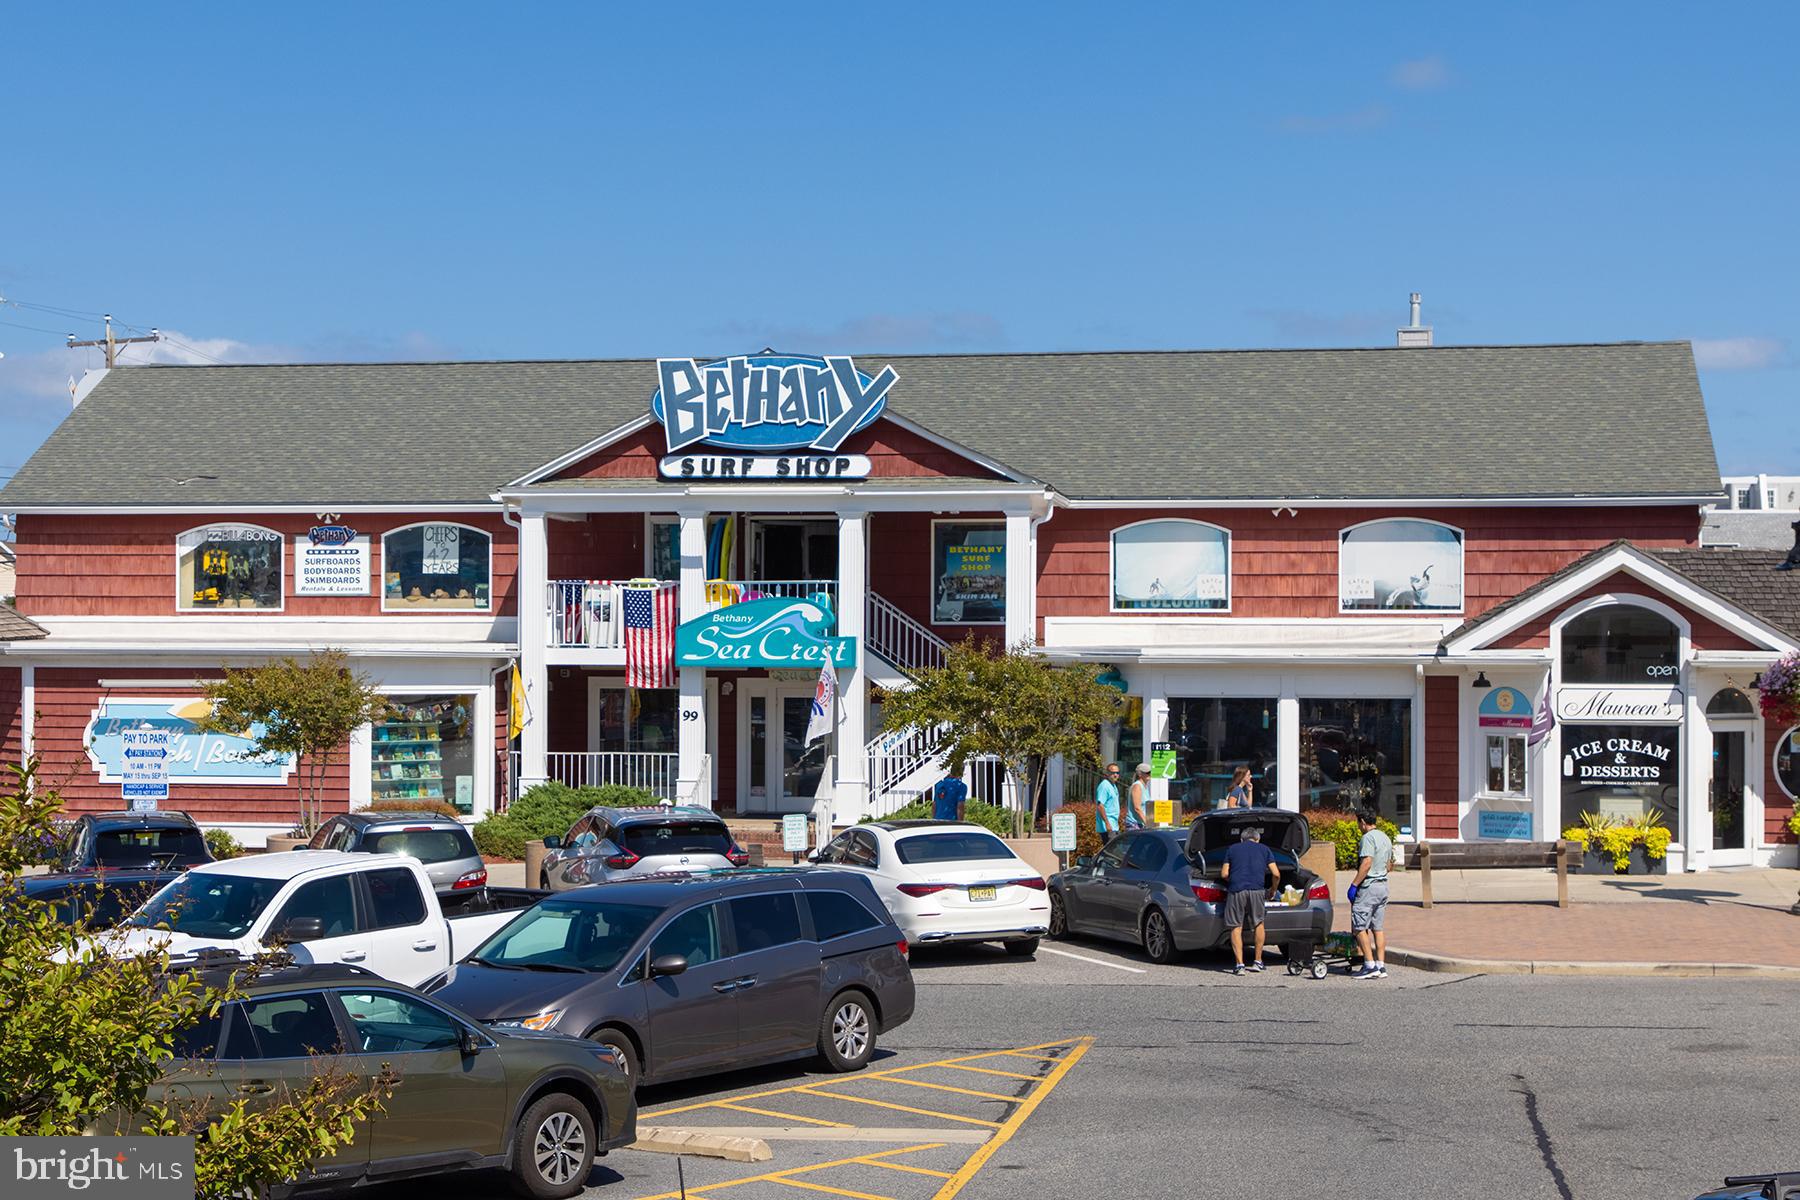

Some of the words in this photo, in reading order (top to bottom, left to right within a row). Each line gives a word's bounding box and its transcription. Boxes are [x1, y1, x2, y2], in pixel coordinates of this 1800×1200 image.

[681, 458, 754, 476] SURF
[776, 457, 851, 476] SHOP
[223, 530, 278, 541] BILLABONG
[427, 548, 449, 563] 42
[304, 567, 361, 575] BODYBOARDS
[423, 563, 459, 574] YEARS
[712, 614, 754, 624] Bethany
[682, 626, 750, 661] Sea
[759, 626, 847, 662] Crest
[1646, 665, 1679, 678] open
[1564, 691, 1672, 718] Maureen's
[682, 710, 698, 721] 99
[124, 734, 136, 744] PAY
[138, 734, 148, 744] TO
[149, 734, 168, 744] PARK
[1571, 741, 1603, 760] ICE
[1606, 738, 1671, 761] CREAM
[1614, 752, 1627, 764] &
[1580, 766, 1660, 778] DESSERTS
